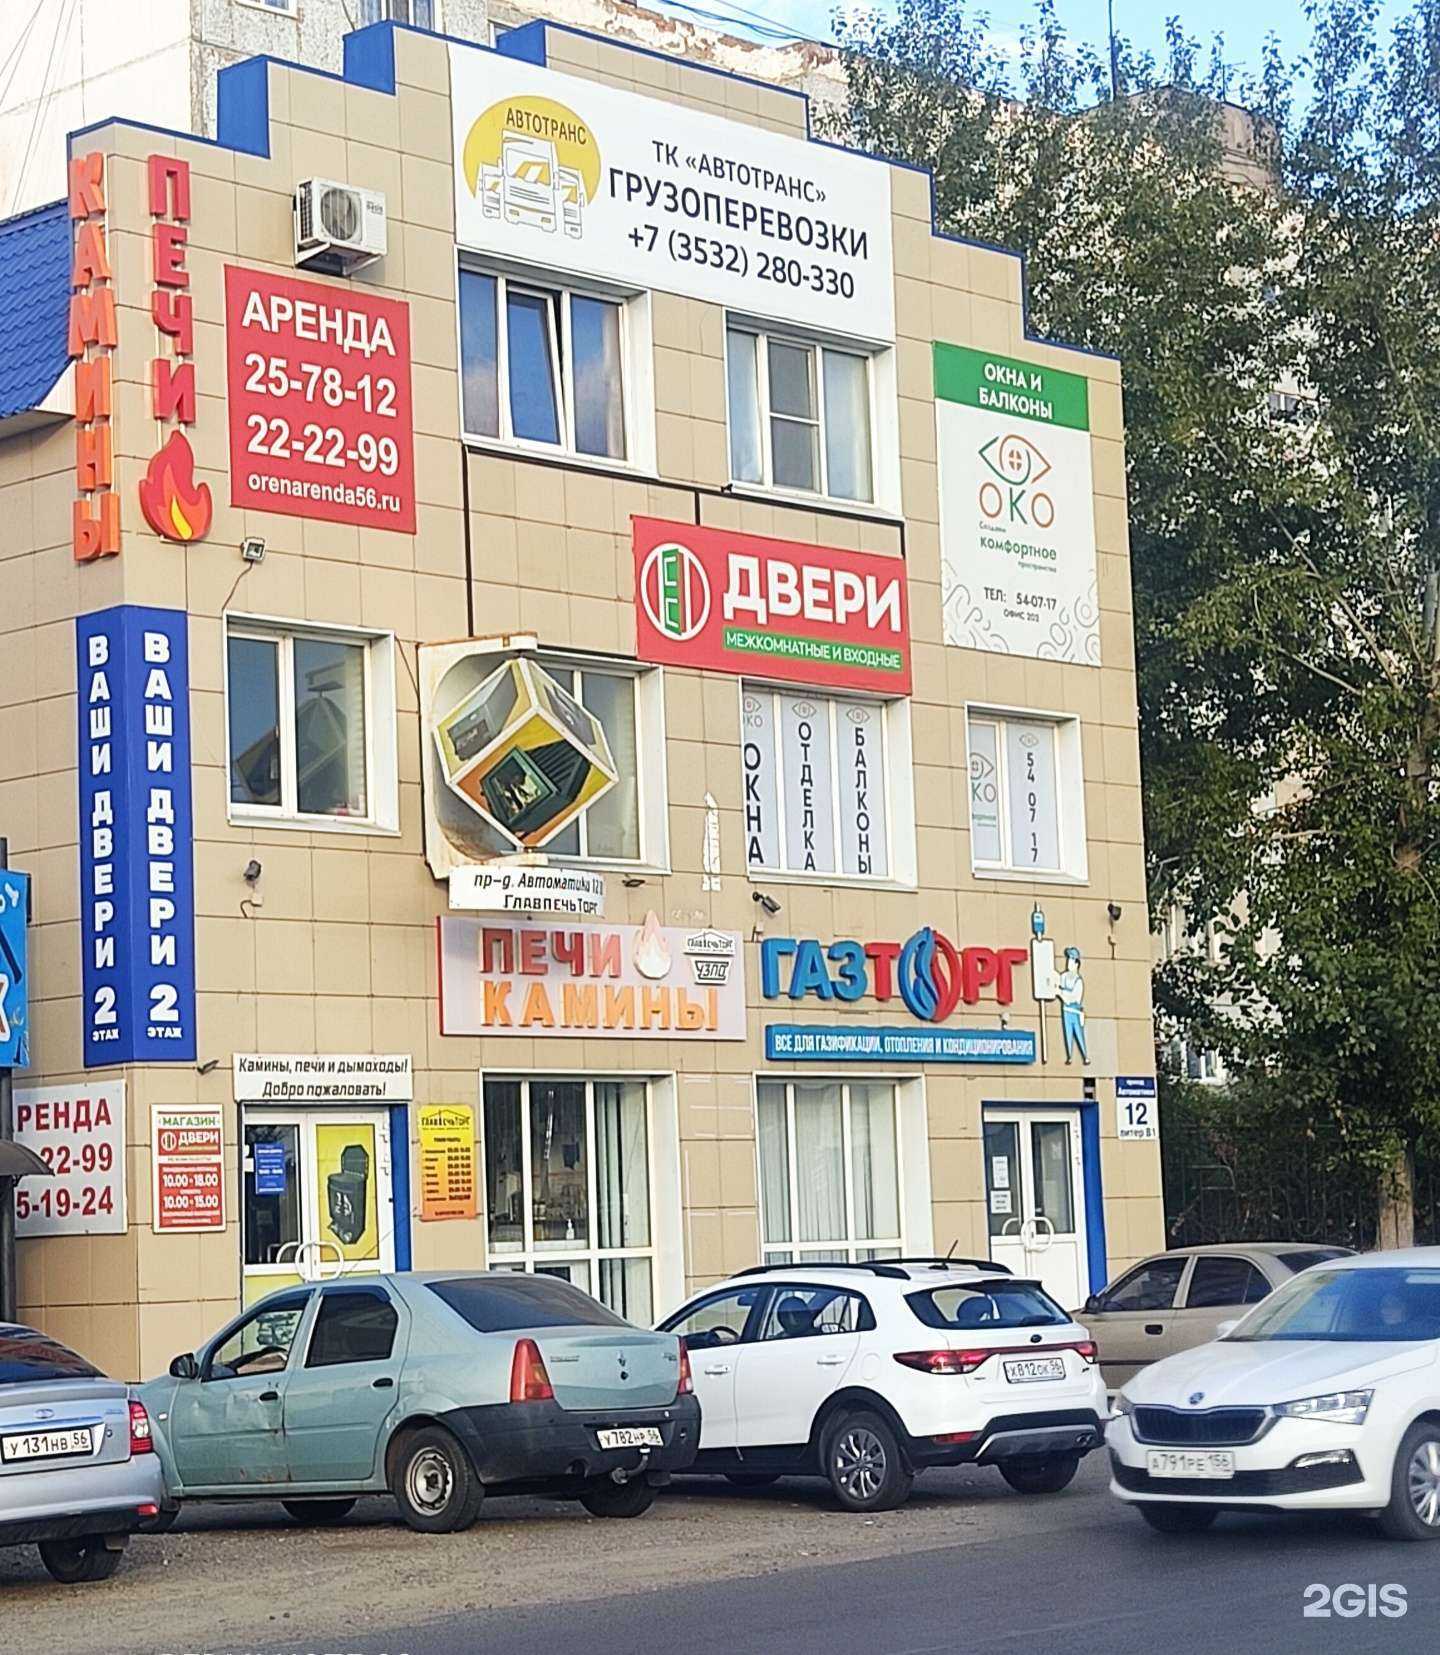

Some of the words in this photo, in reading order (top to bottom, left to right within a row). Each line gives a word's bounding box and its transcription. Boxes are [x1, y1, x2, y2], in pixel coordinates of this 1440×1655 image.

[506, 107, 587, 145] АВТОТРАНС
[652, 140, 679, 168] ТК
[686, 153, 826, 203] «АВТОТРАНС»
[609, 168, 868, 259] ГРУЗОПЕРЕВОЗКИ
[628, 225, 658, 252] +7
[669, 229, 748, 278] (3532)
[757, 252, 854, 298] 280-330
[148, 154, 196, 424] ПЕЧИ
[241, 291, 397, 358] АРЕНДА
[68, 152, 120, 561] КАМИНЫ
[244, 353, 397, 416] 25-78-12
[984, 362, 1027, 388] ОКНА
[1031, 374, 1042, 392] И
[979, 387, 1053, 419] БАЛКОНЫ
[247, 414, 399, 475] 22-22-99
[248, 472, 400, 512] orenarenda56.ru
[980, 482, 1054, 528] ОКО
[980, 536, 1057, 560] комфортное
[723, 553, 902, 633] ДВЕРИ
[984, 586, 1007, 603] ТЕЛ:
[726, 633, 831, 660] МЕЖКОМНАТНЫЕ
[833, 644, 842, 659] И
[843, 647, 901, 668] ВХОДНЫЕ
[88, 634, 112, 775] ВАШИ
[143, 632, 173, 773] ВАШИ
[743, 742, 765, 865] ОКНА
[798, 721, 816, 872] ОТДЕЛКА
[855, 727, 872, 875] БАЛКОНЫ
[972, 782, 997, 803] КО
[92, 790, 115, 969] ДВЕРИ
[147, 789, 176, 967] ДВЕРИ
[480, 927, 623, 978] ПЕЧИ
[761, 926, 1028, 1023] ГАЗТОРГ
[94, 986, 118, 1025] 2
[149, 984, 180, 1022] 2
[481, 980, 719, 1032] КАМИНЫ
[92, 1026, 119, 1042] ЭТАЖ
[147, 1026, 183, 1040] ЭТАЖ
[775, 1035, 792, 1052] ВСЕ
[793, 1035, 814, 1053] ДЛЯ
[815, 1035, 883, 1054] ГАЗИФИКАЦИИ,
[884, 1037, 934, 1054] ОТОПЛЕНИЯ
[935, 1038, 942, 1054] И
[239, 1057, 292, 1074] Камины,
[294, 1061, 325, 1073] печи
[328, 1061, 336, 1073] и
[337, 1058, 408, 1074] дымоходы!
[262, 1081, 304, 1100] Добро
[306, 1082, 387, 1098] пожаловать!
[17, 1098, 112, 1133] РЕНДА
[162, 1116, 216, 1126] МАГАЗИН
[1125, 1102, 1148, 1125] 12
[40, 1142, 113, 1174] 22-99
[178, 1131, 219, 1146] ДВЕРИ
[16, 1186, 113, 1219] 5-19-24
